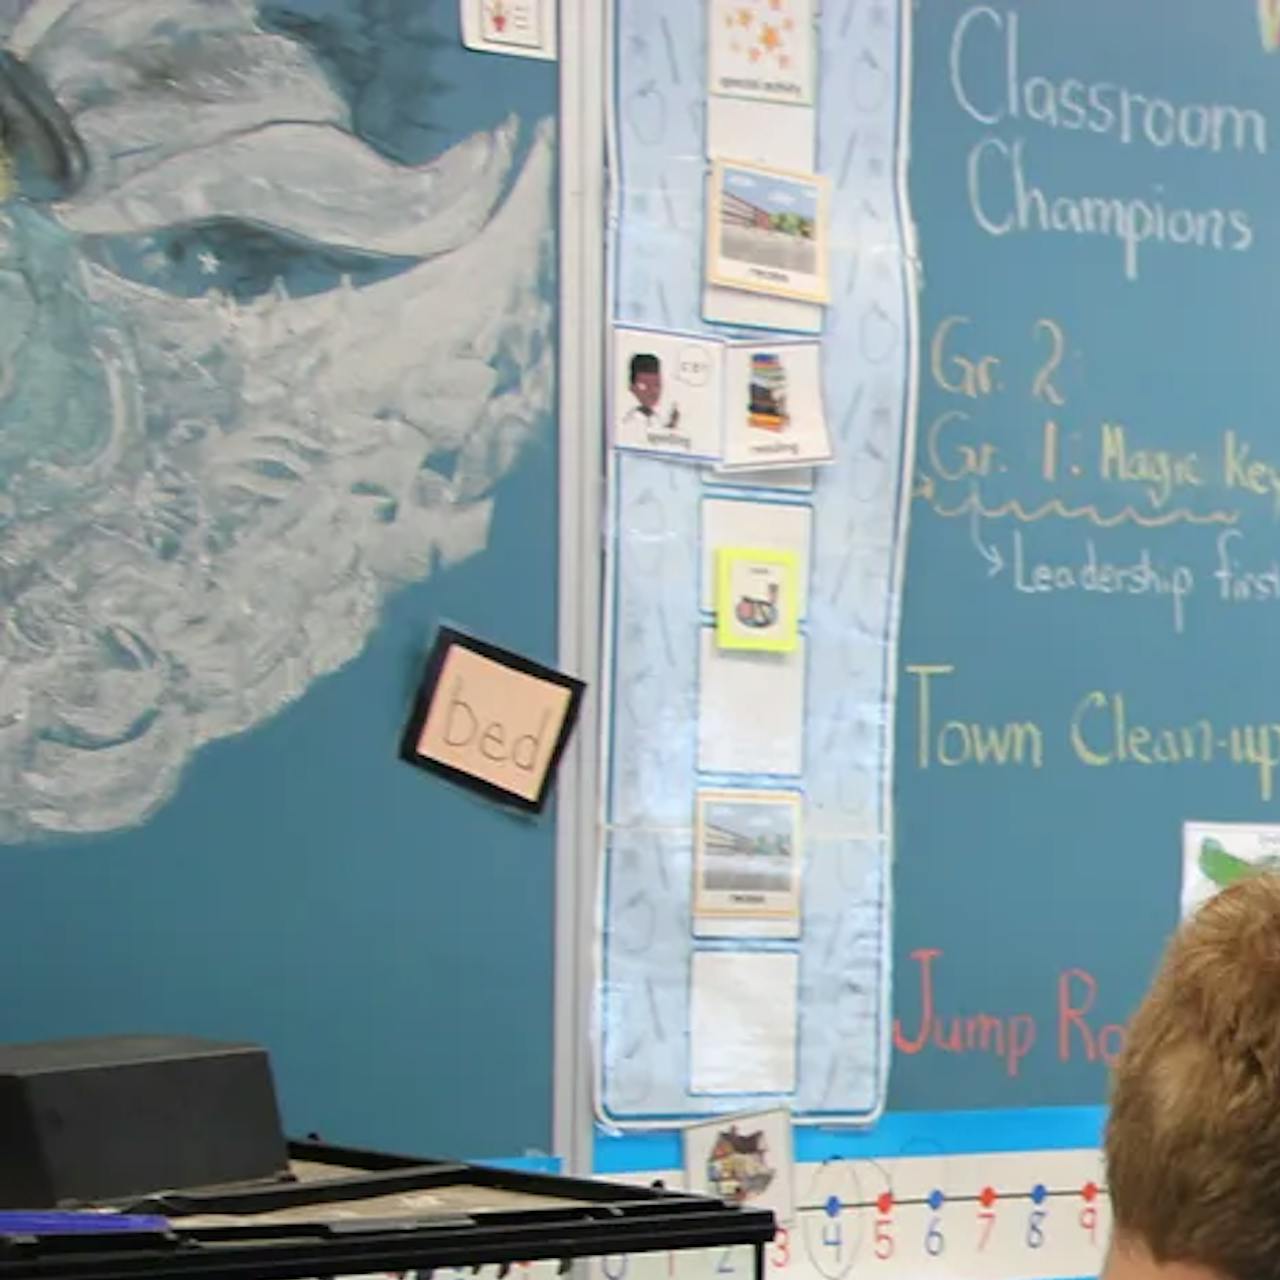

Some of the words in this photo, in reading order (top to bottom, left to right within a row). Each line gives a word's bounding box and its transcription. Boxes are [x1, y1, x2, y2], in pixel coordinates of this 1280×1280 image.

[949, 5, 1268, 154] Classroom
[966, 138, 1255, 281] Champions
[930, 315, 1004, 399] Gr.
[926, 410, 1009, 482] Gr.
[1101, 421, 1208, 509] Magic
[1014, 528, 1194, 634] Leadership
[441, 672, 554, 773] bed
[904, 664, 1043, 768] Town
[892, 947, 1036, 1077] Jump
[1057, 968, 1123, 1065] Ro
[823, 1223, 843, 1263] 4
[873, 1219, 896, 1260] 5
[924, 1216, 945, 1257] 6
[976, 1212, 997, 1254] 7
[1027, 1210, 1048, 1250] 8
[1078, 1207, 1098, 1247] 9
